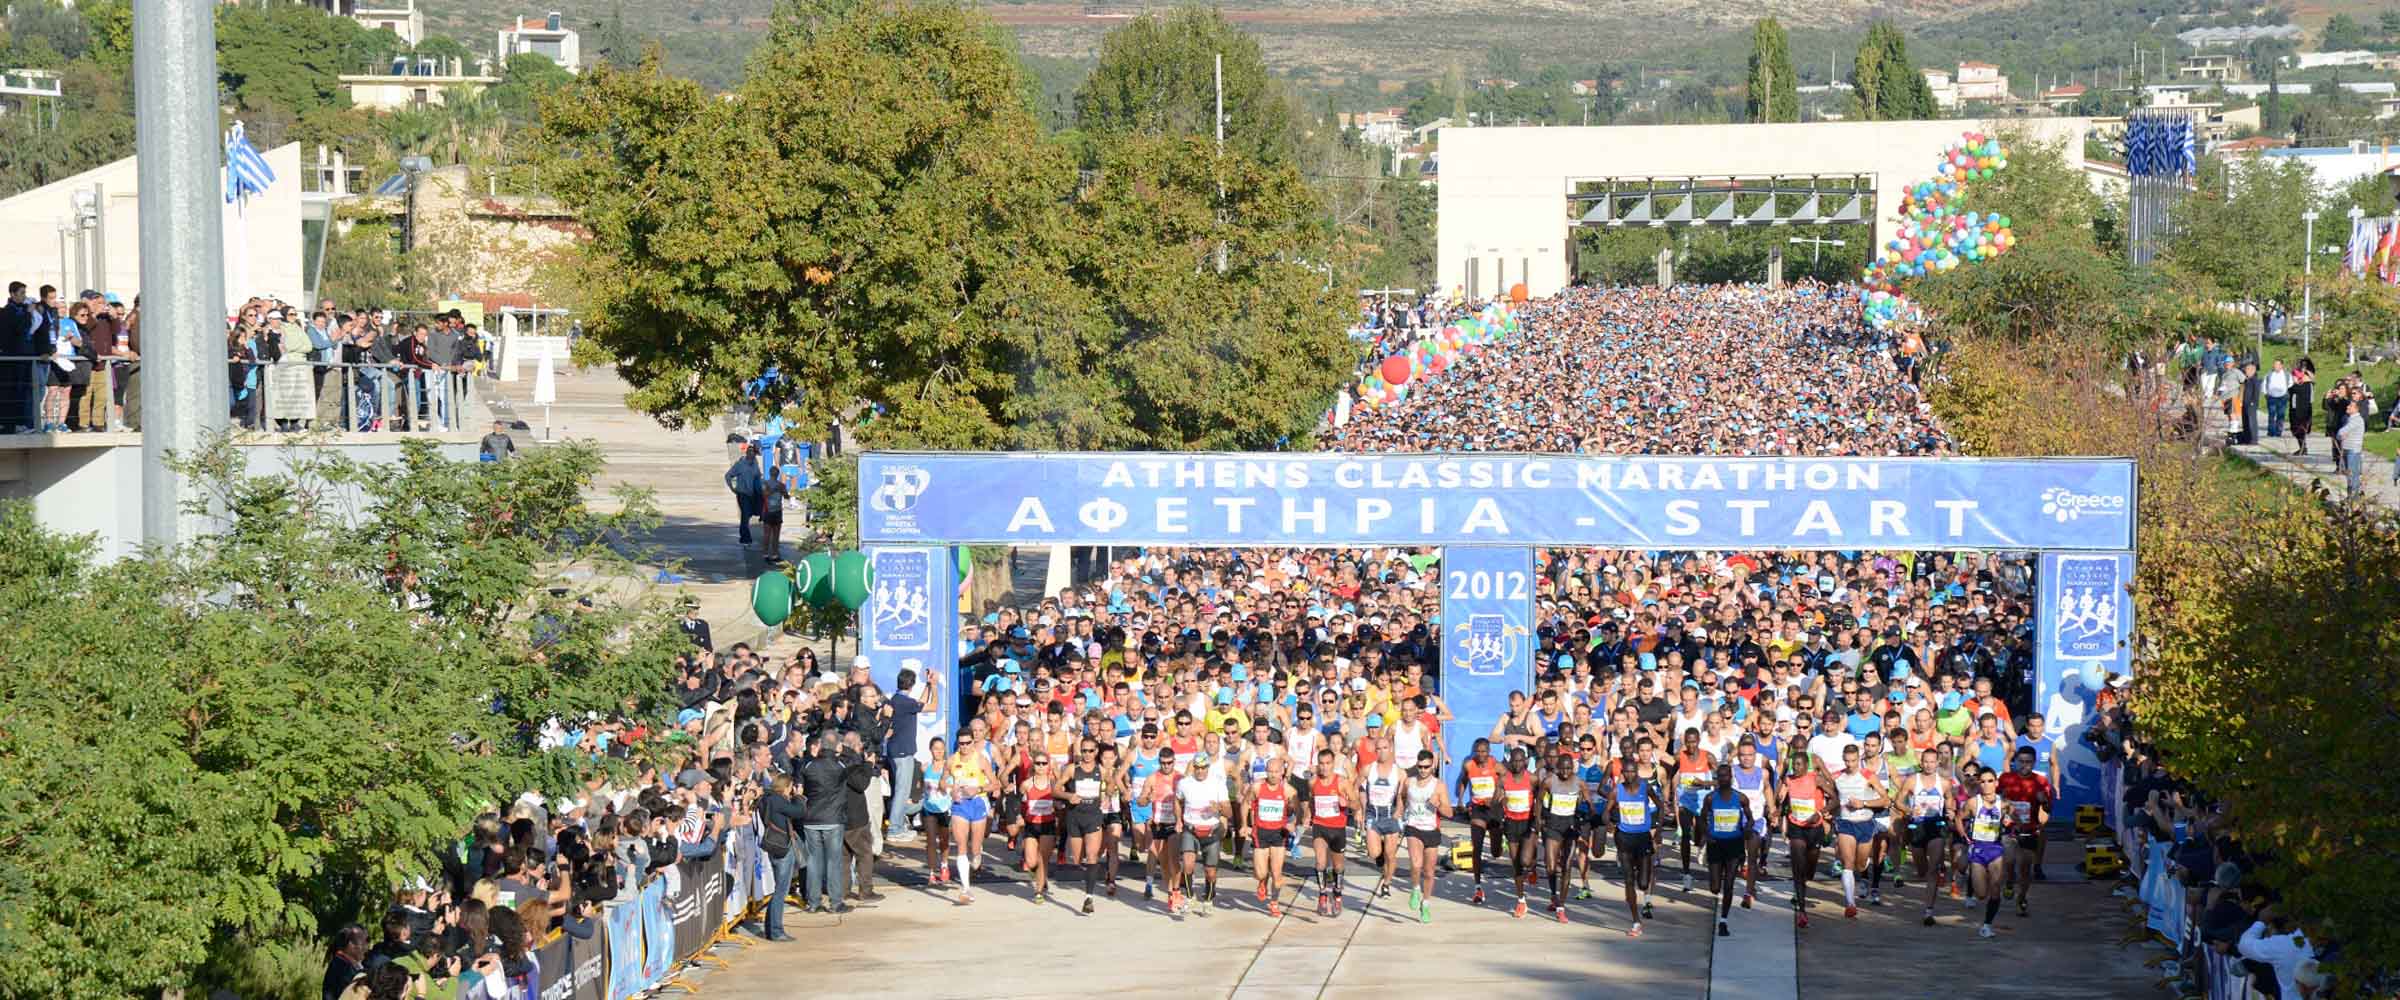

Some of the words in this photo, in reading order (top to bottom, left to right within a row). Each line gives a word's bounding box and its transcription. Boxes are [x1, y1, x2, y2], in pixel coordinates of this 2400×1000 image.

[1103, 462, 1309, 489] ATHENS
[1334, 462, 1551, 489] CLASSIC
[1577, 463, 1880, 490] MARATHON
[2056, 492, 2125, 508] Greece
[1007, 497, 1509, 534] ΑΦΕΤΗΡΙΑ
[1665, 499, 1978, 537] START
[1449, 570, 1528, 600] 2012
